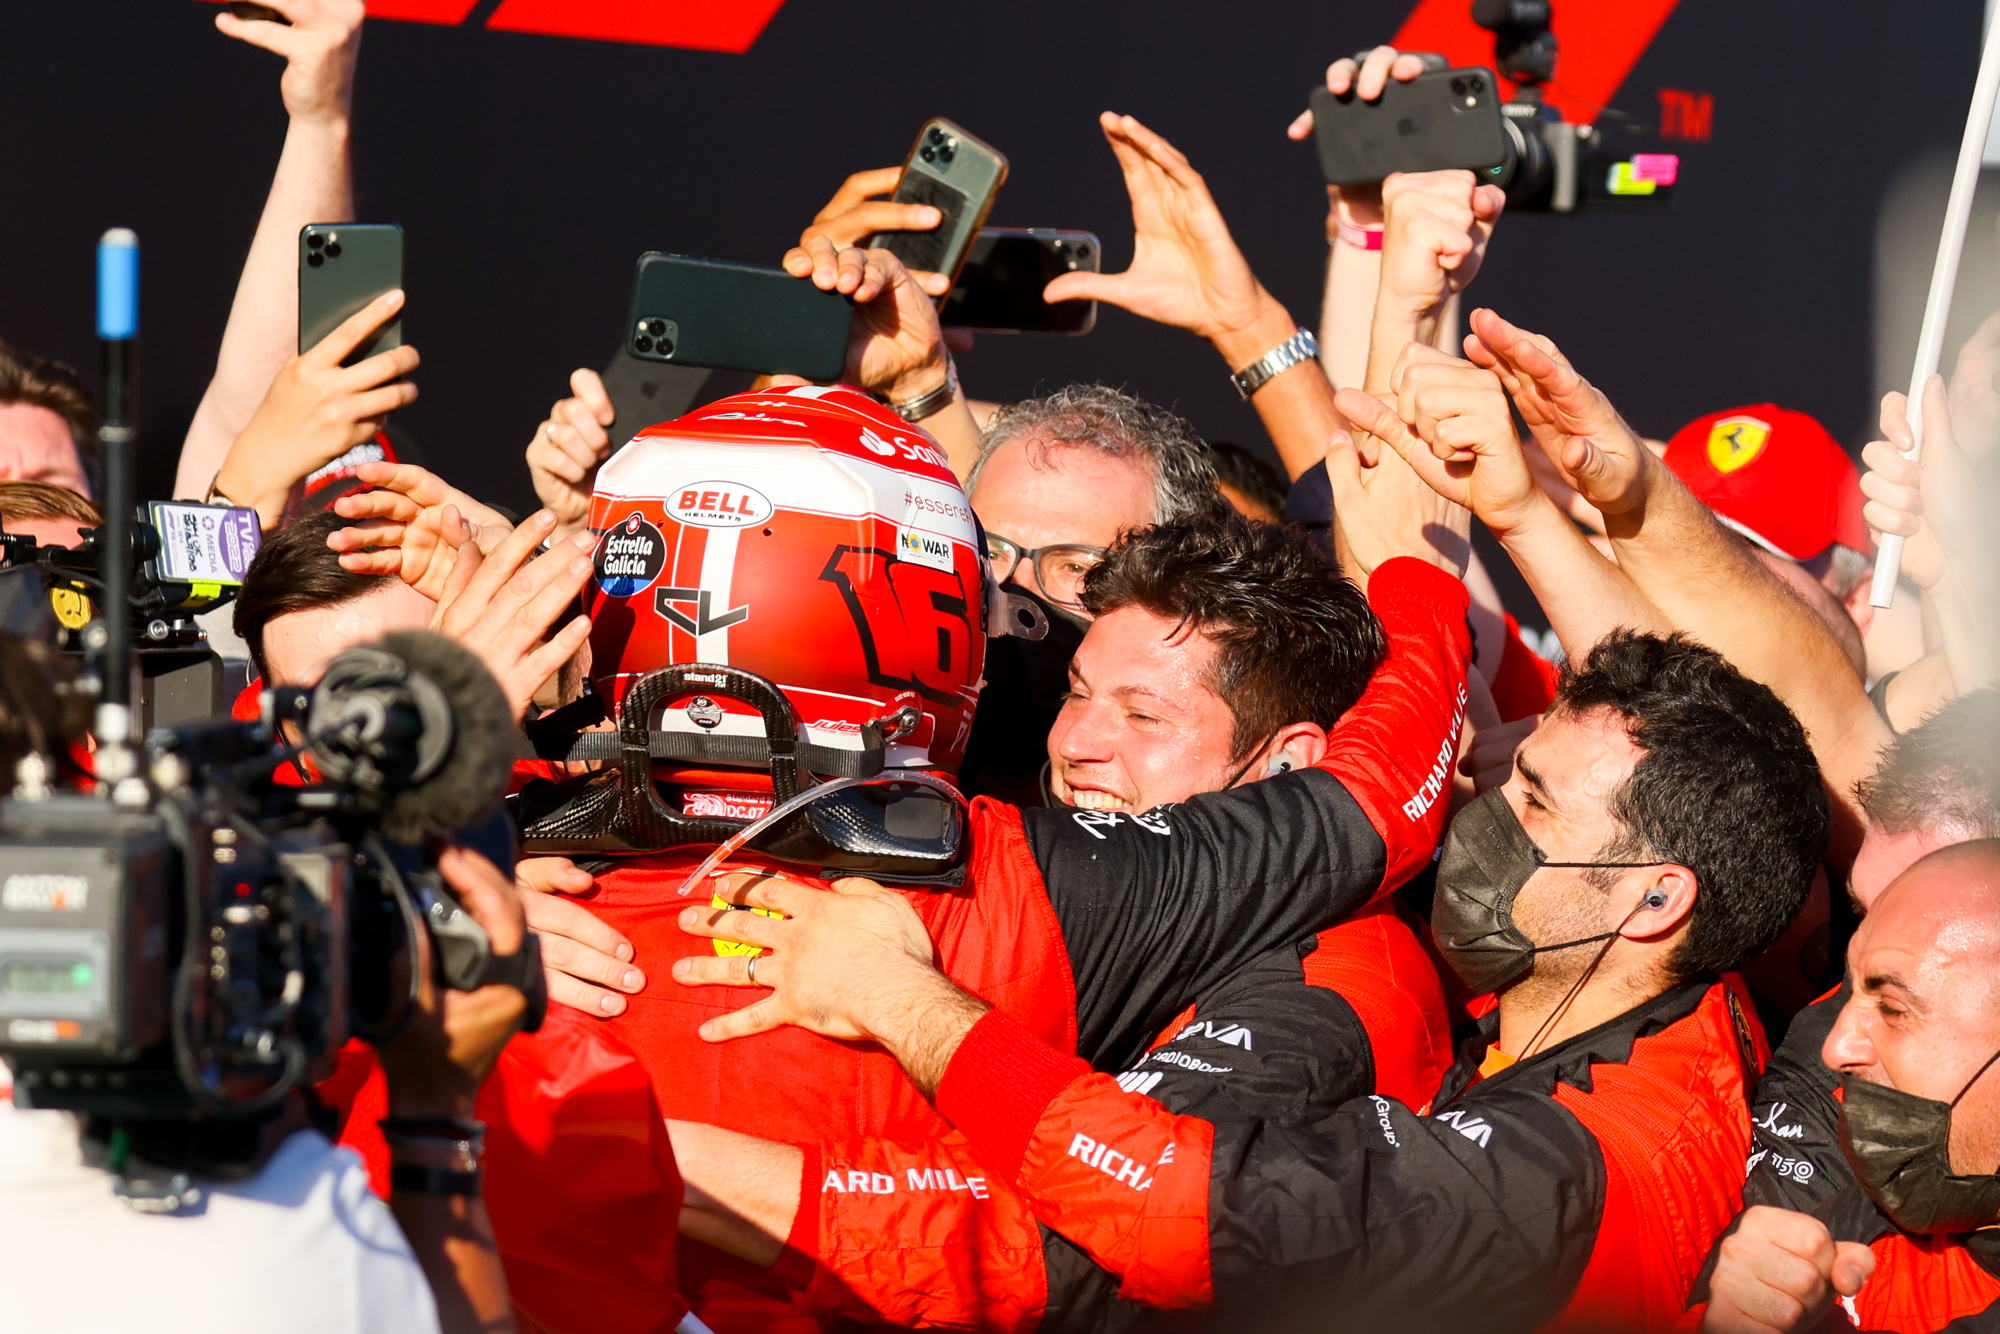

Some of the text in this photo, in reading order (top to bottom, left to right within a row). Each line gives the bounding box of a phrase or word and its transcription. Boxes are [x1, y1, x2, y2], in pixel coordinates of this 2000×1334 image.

[678, 490, 754, 516] BELL
[684, 512, 741, 521] HELMETS
[238, 513, 254, 541] TV
[206, 533, 218, 574] MEDIA
[225, 519, 243, 573] 2022
[605, 535, 653, 555] Estrella
[922, 539, 950, 559] WAR
[604, 555, 646, 575] Galicia
[725, 794, 765, 804] Standard
